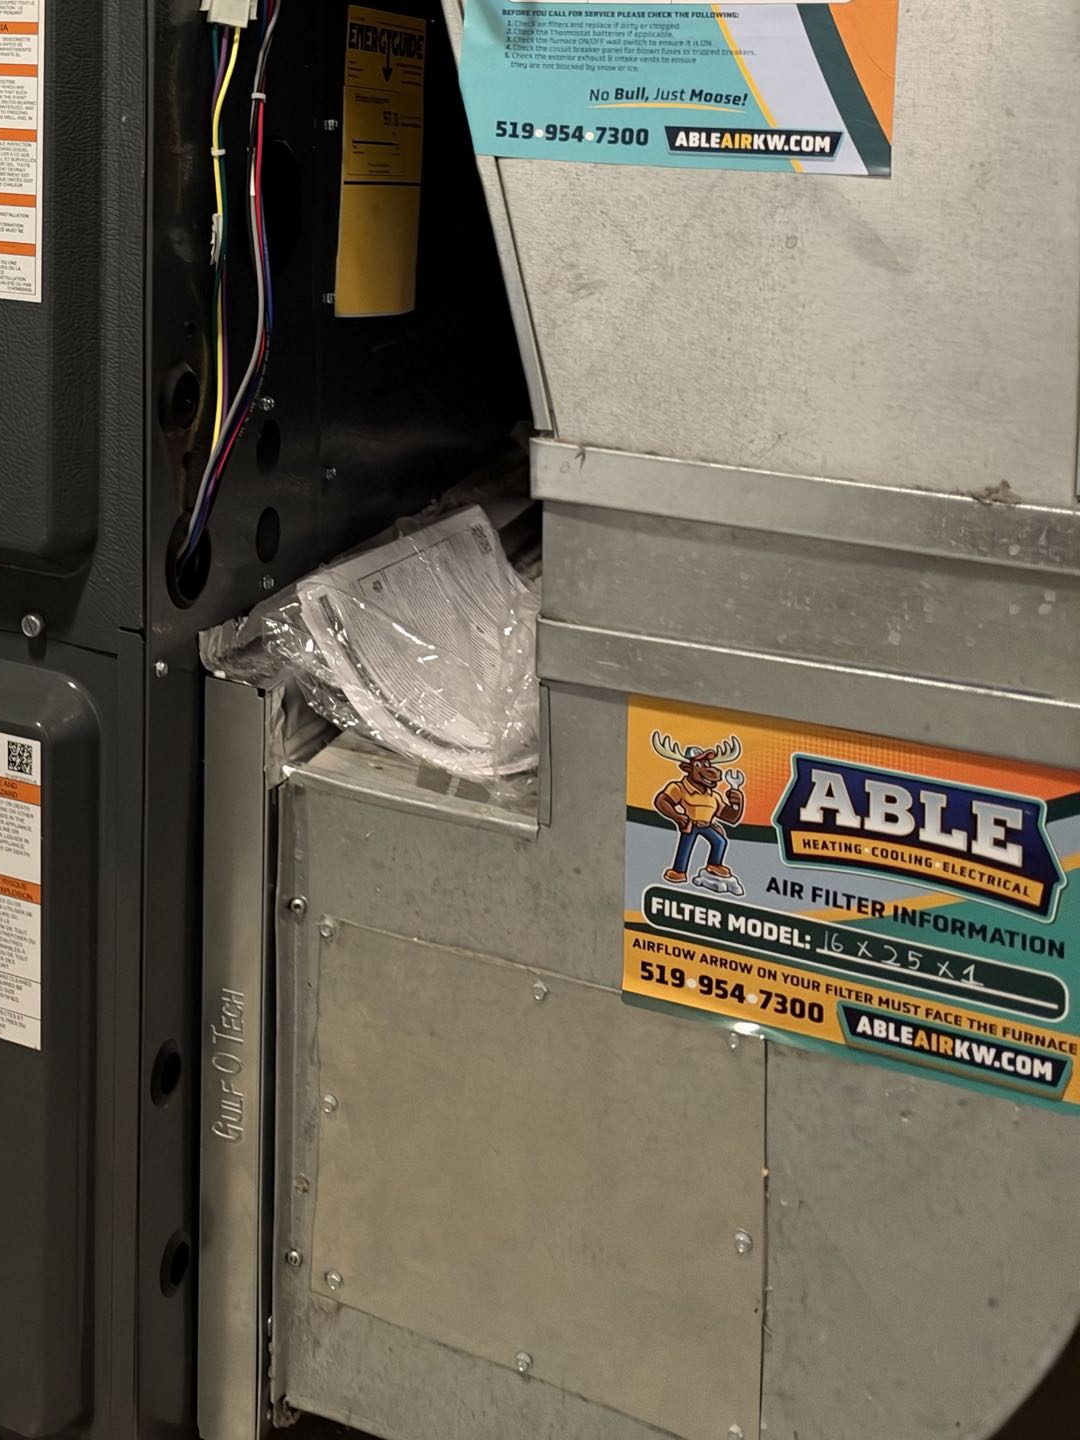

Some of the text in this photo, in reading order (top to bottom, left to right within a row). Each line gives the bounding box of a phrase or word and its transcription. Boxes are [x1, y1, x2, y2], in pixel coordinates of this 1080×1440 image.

[502, 9, 740, 19] BEFORE YOU CALL FOR SERVICE PLEASE CHECK THE FOLLOWING:
[588, 87, 748, 107] No Bull, Just Moose!
[674, 130, 832, 154] ABLEAIRKW.COM
[798, 767, 1024, 868] ABLE
[802, 837, 1031, 898] HEATING COOLING ELECTRICAL
[650, 896, 812, 951] FILTER MODEL:
[765, 876, 1066, 960] AIR FILTER INFORMATION
[632, 937, 1078, 1056] AIRFLOW ARROW ON YOUR FILTER MUST FACE THE FURNACE
[885, 944, 924, 971] 25
[961, 964, 985, 988] 1
[211, 987, 245, 1143] GULF O TECH
[855, 1014, 1053, 1082] ABLEAIRKW.COM
